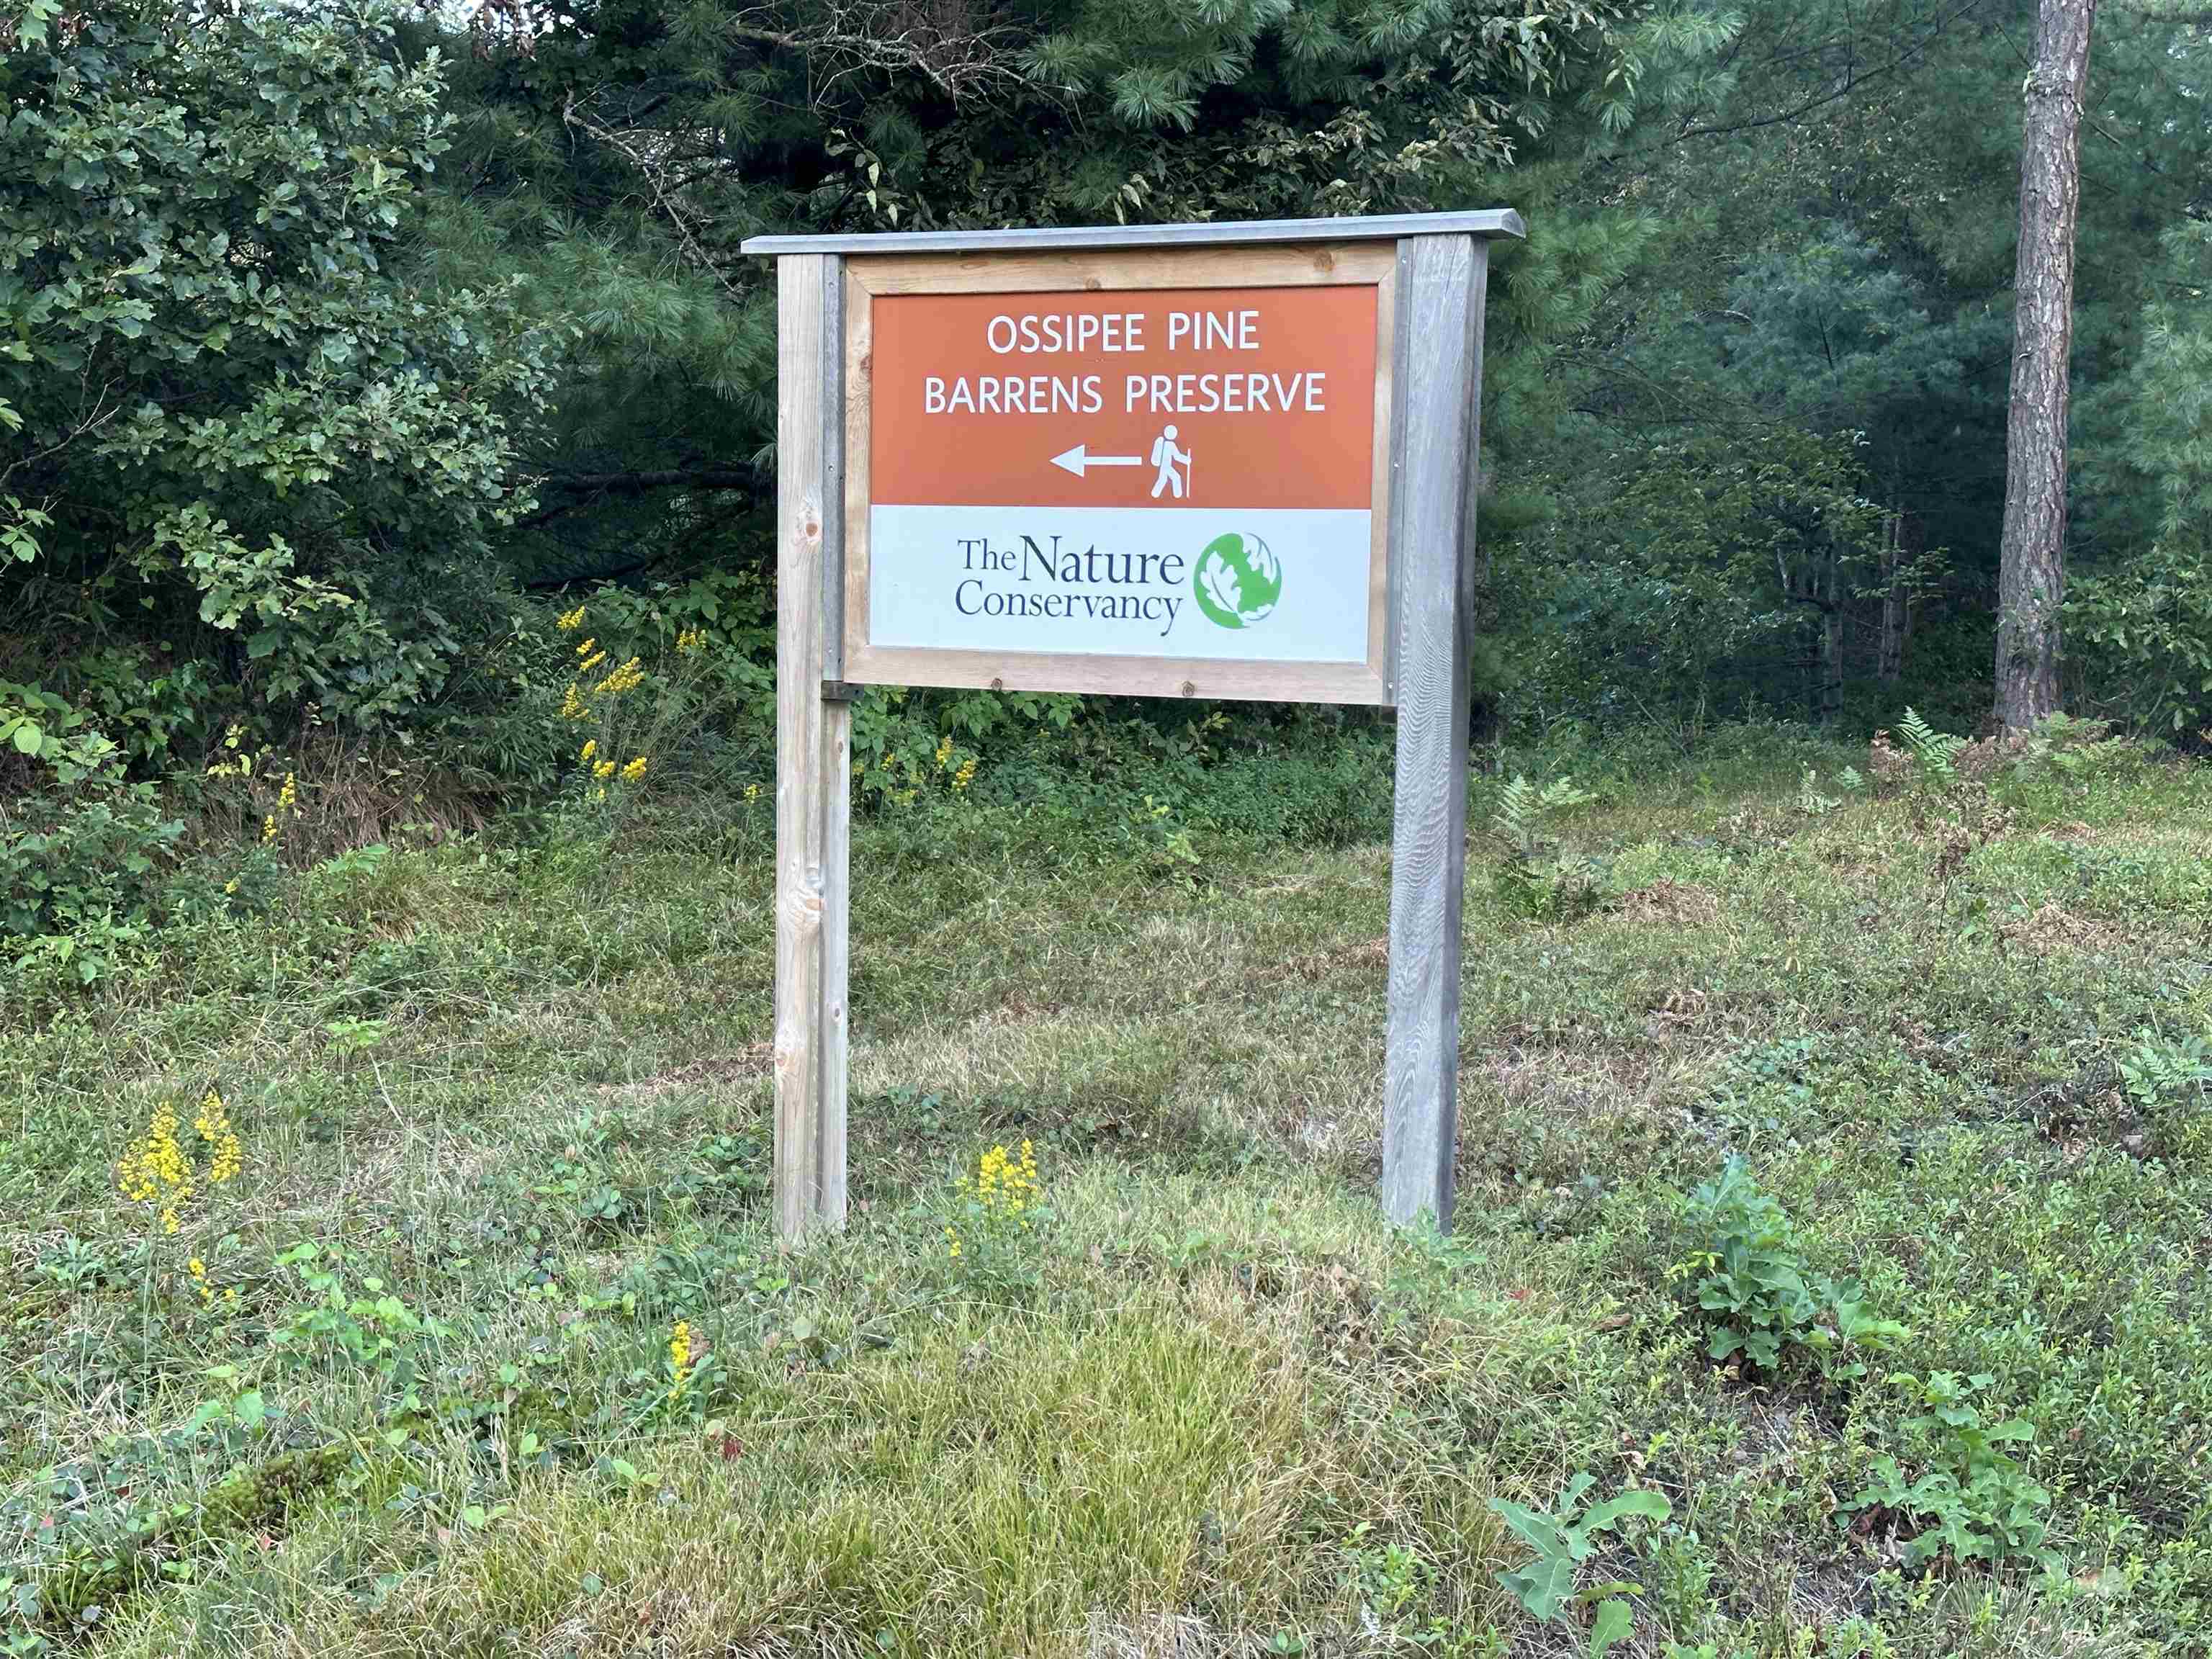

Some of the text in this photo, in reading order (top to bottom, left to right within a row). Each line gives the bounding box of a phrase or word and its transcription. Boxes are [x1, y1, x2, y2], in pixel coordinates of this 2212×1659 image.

[986, 310, 1259, 354] OSSIPEE PINE
[925, 372, 1326, 414] BARRENS PRESERVE
[958, 535, 1185, 586] The Nature
[956, 580, 1183, 637] Conservancy
